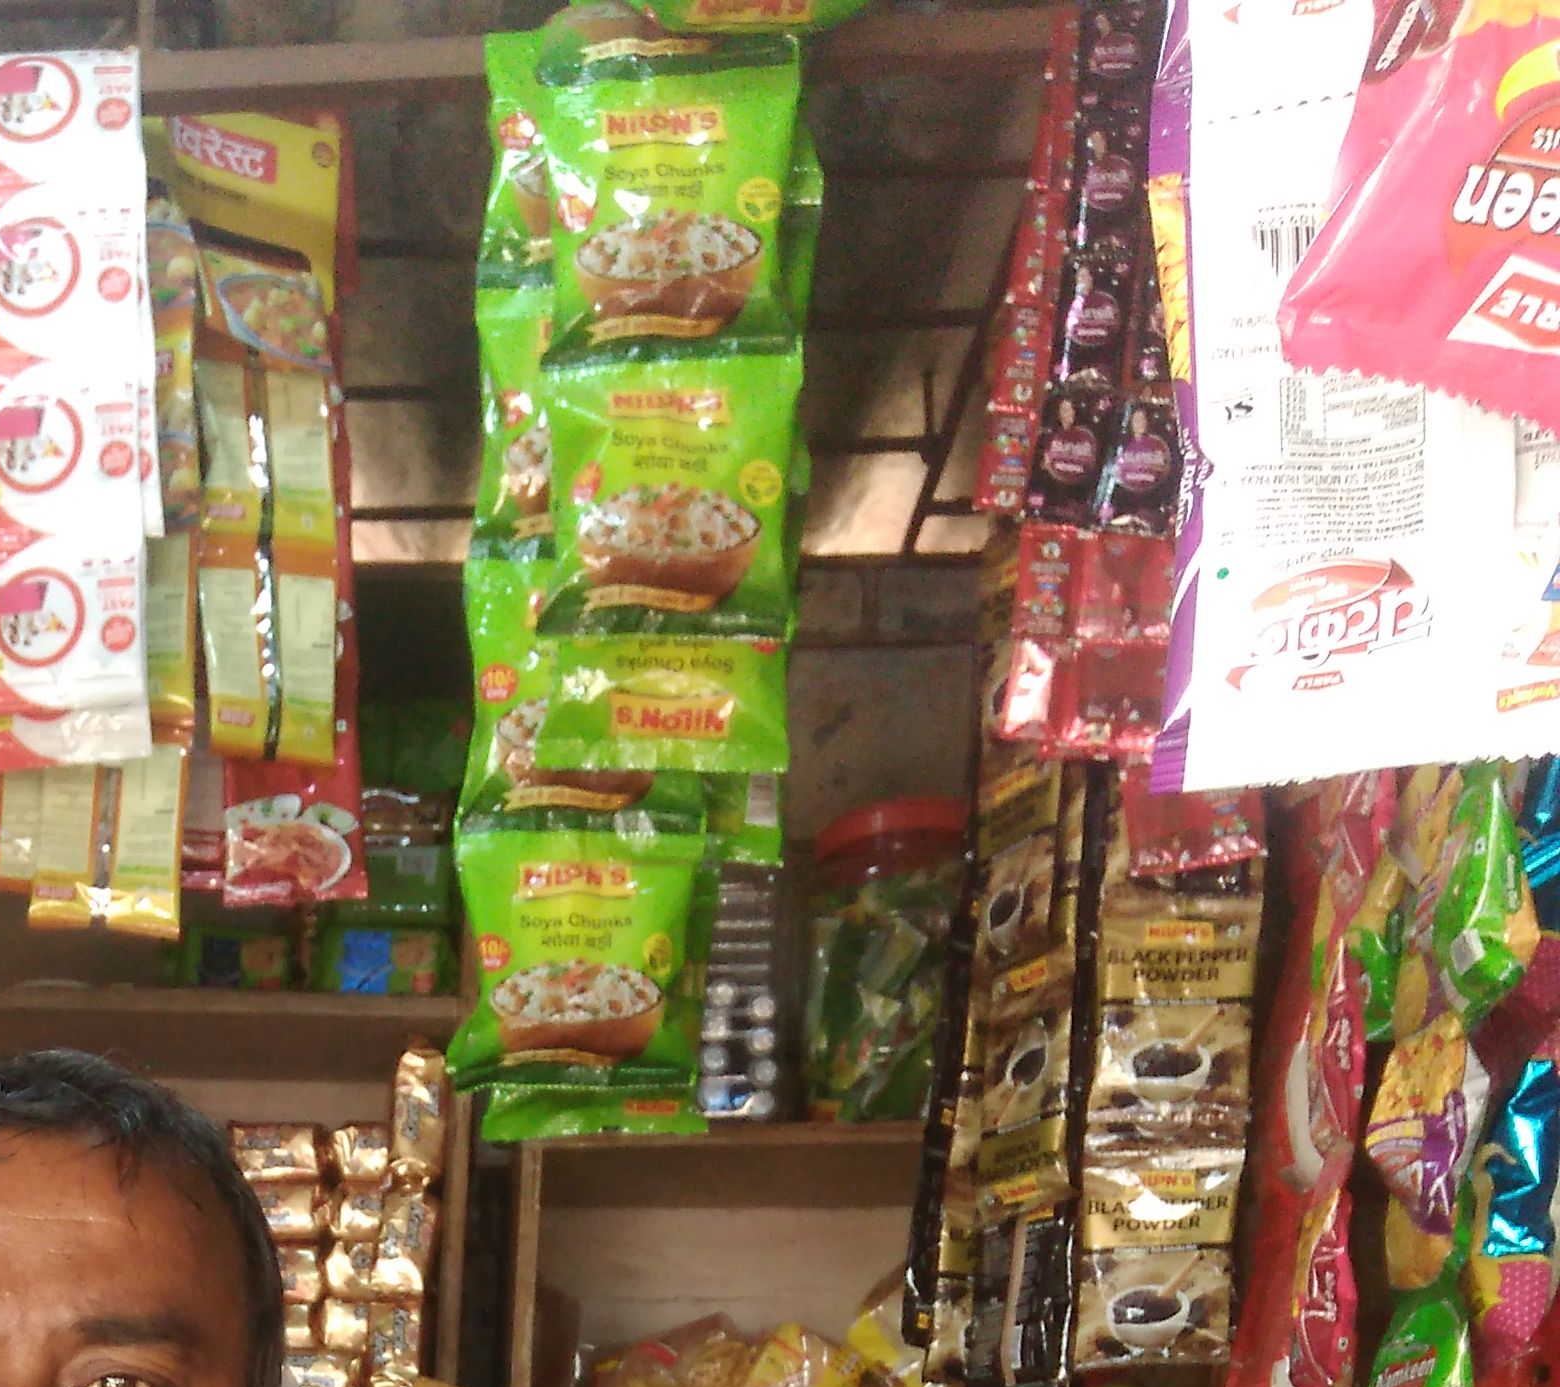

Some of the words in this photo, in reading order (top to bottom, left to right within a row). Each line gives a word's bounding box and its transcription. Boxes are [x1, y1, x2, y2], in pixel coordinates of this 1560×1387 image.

[604, 164, 651, 183] Soya
[656, 162, 726, 179] Chunks
[612, 431, 657, 450] Soya
[662, 437, 729, 455] Chunks
[616, 655, 685, 673] Chunks
[692, 657, 734, 674] Soya
[616, 706, 725, 732] NILON'S
[520, 914, 562, 930] Soya
[568, 912, 633, 928] Chunks
[1107, 948, 1170, 964] BLACK
[1175, 949, 1248, 966] PEPPER
[1132, 966, 1220, 983] POWDER
[1113, 1216, 1202, 1232] POWDER
